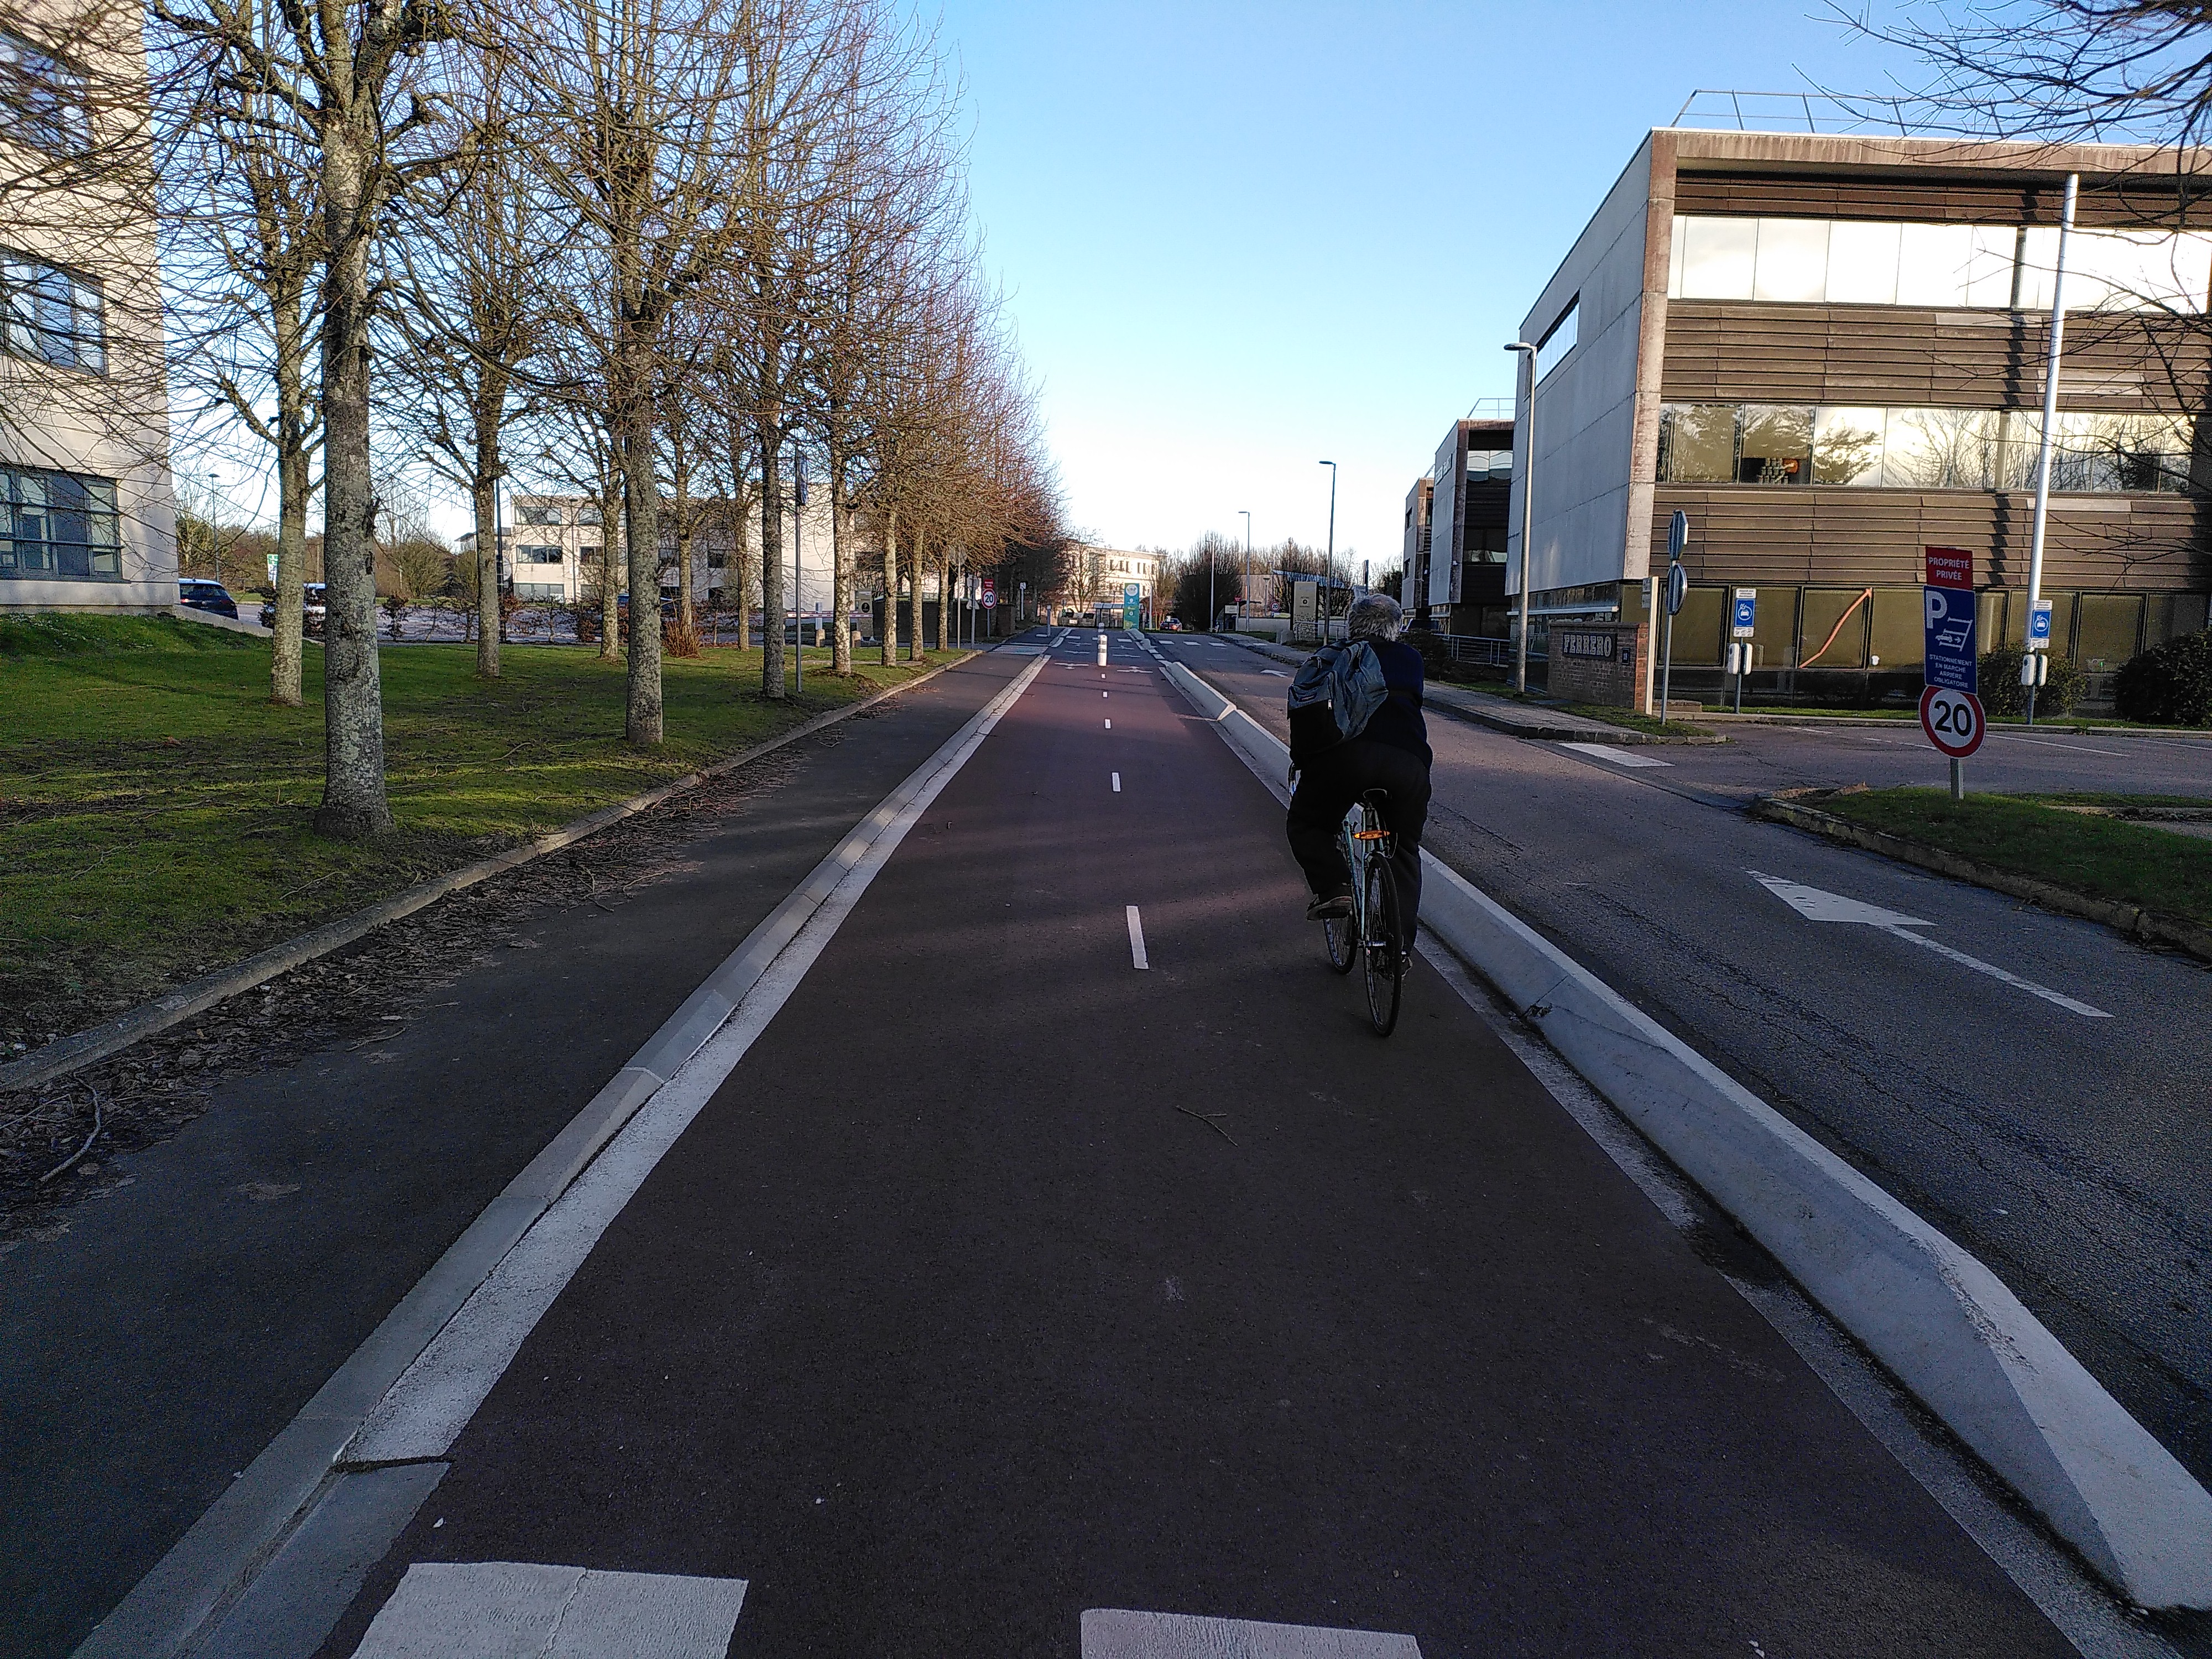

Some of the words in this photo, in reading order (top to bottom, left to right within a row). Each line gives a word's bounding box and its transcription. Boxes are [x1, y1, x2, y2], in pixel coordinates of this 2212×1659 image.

[1928, 557, 1970, 569] PROPRIÉTÉ
[1936, 570, 1963, 581] PRIVÉE
[985, 594, 994, 603] 20
[1926, 590, 1947, 629] P
[1563, 634, 1611, 657] FERRERO
[1929, 654, 1973, 666] STATIONNEMENT
[1943, 664, 1966, 673] MARCHE
[1934, 676, 1969, 688] OBLIGATOIRE
[1934, 700, 1972, 737] 20
